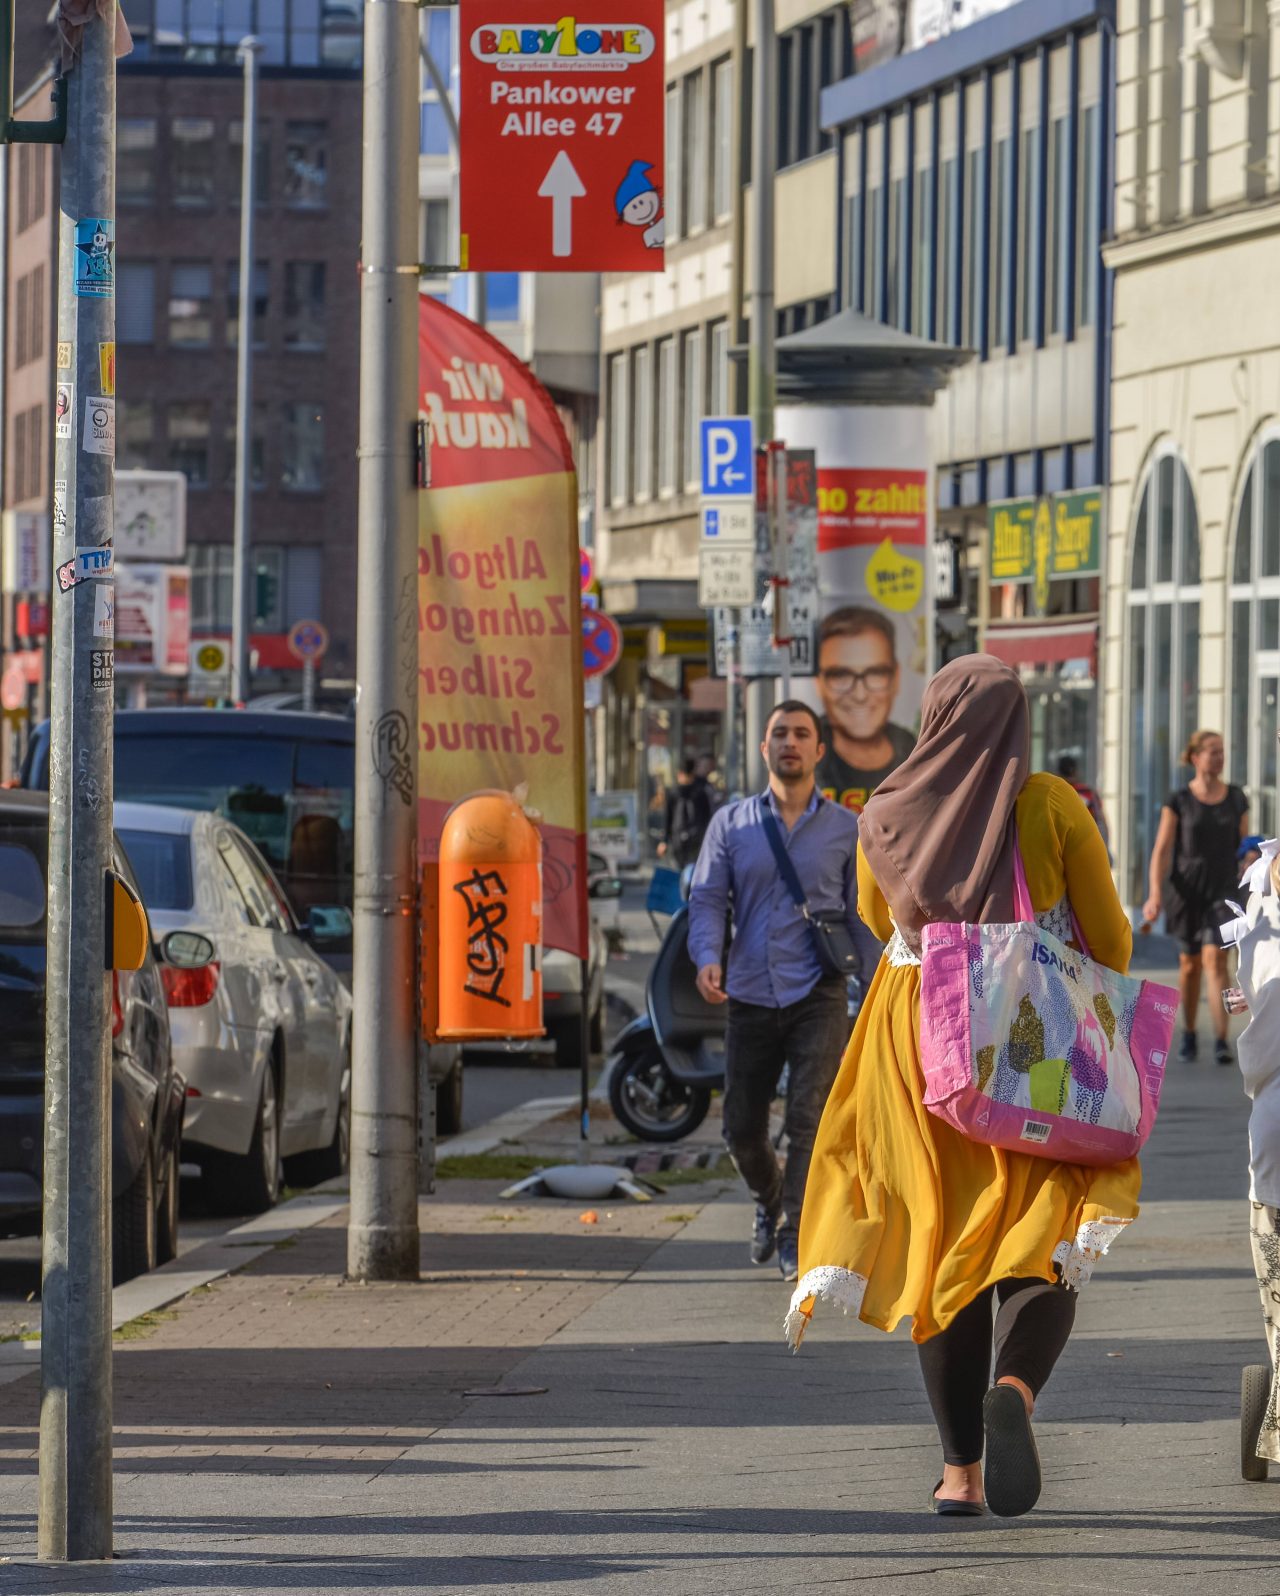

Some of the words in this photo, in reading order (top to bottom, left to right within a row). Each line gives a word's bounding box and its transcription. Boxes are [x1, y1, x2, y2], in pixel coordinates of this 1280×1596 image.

[490, 80, 635, 105] Pankower
[500, 111, 576, 136] Allee
[585, 112, 623, 136] 47
[707, 428, 737, 487] P
